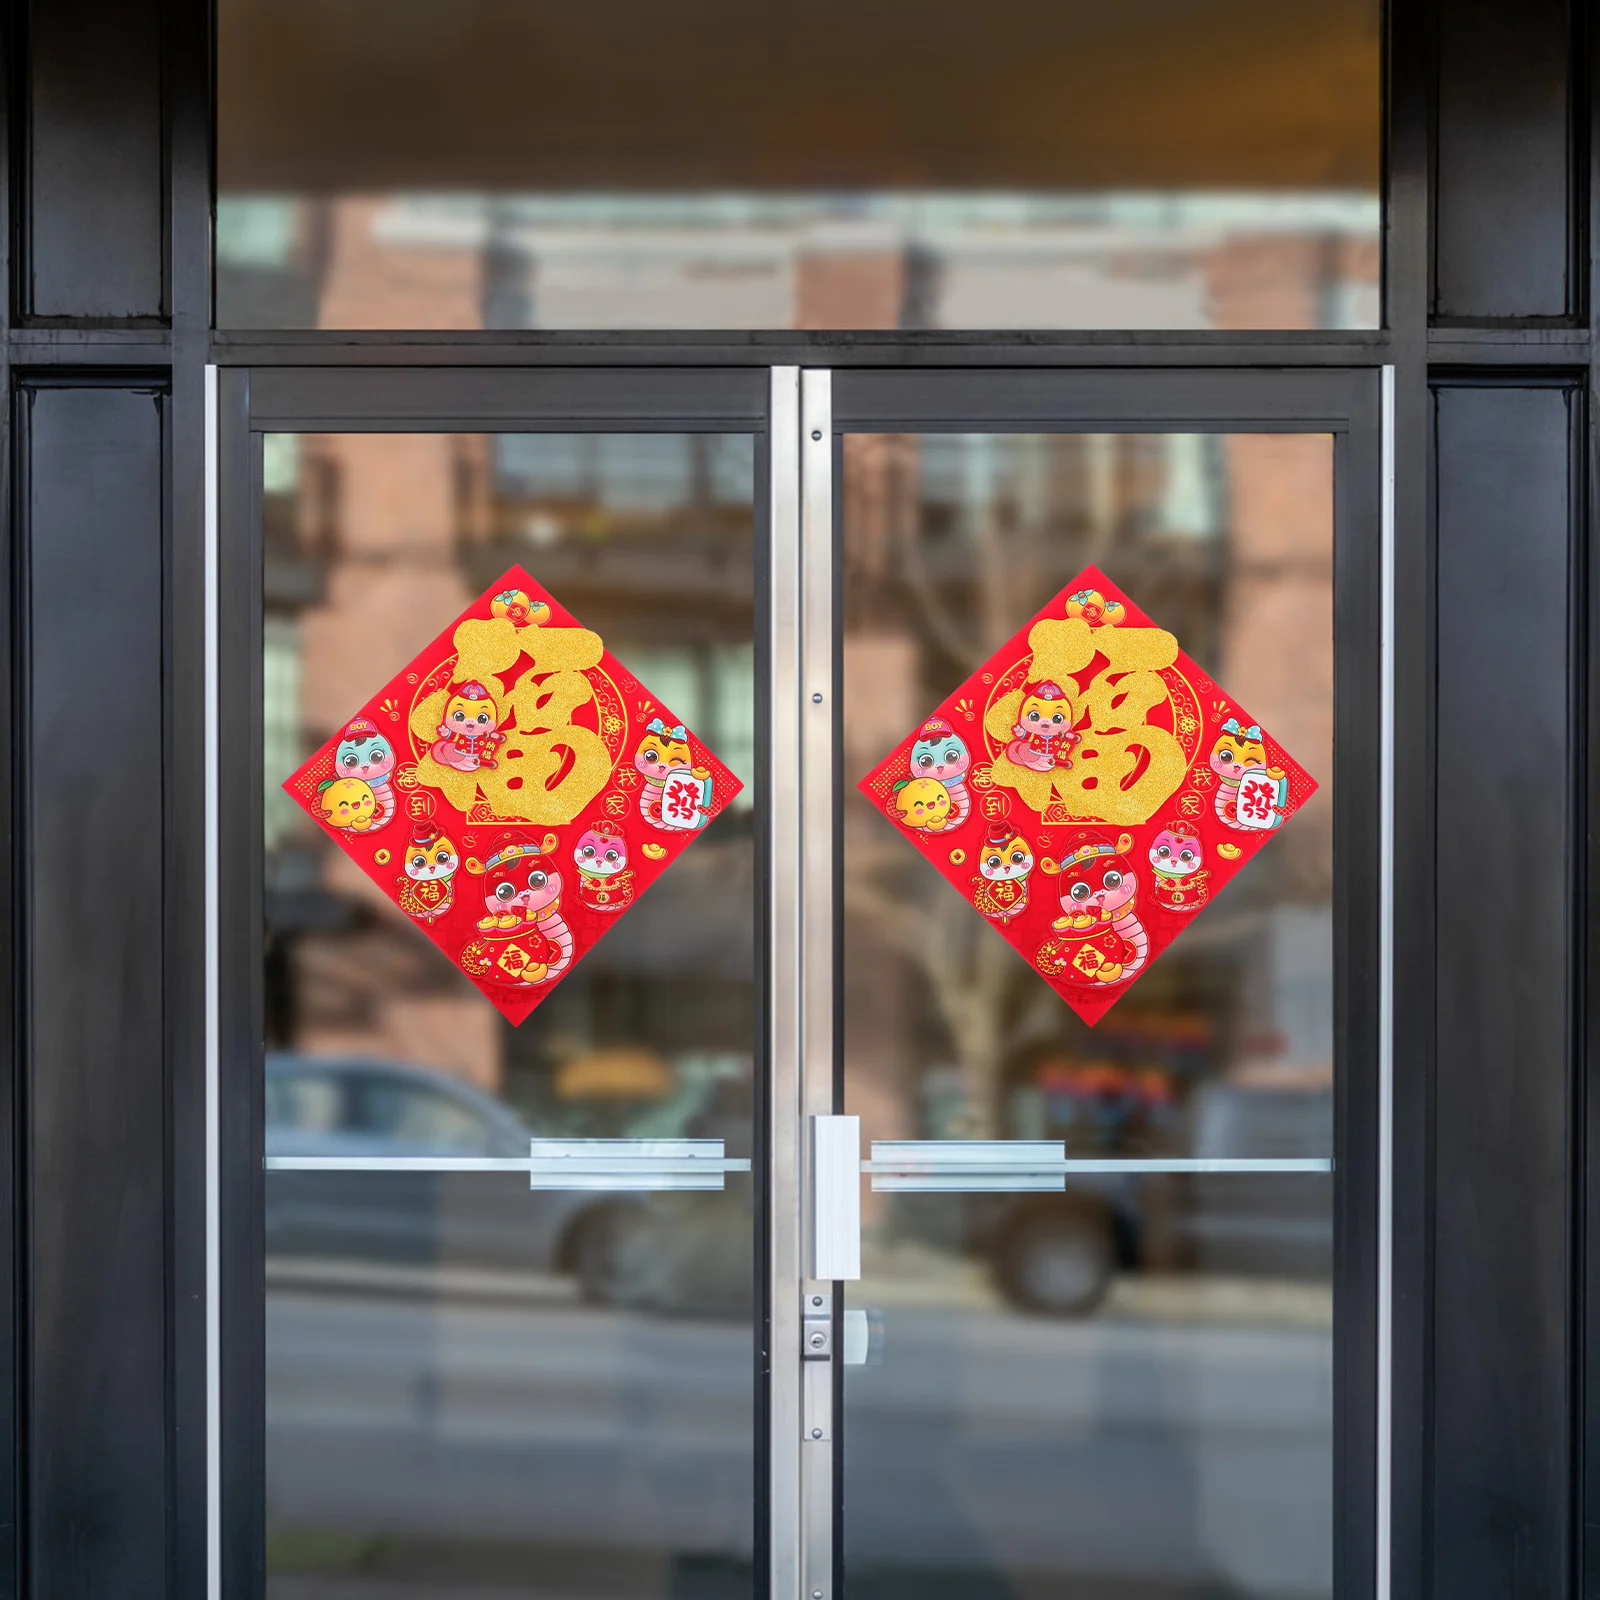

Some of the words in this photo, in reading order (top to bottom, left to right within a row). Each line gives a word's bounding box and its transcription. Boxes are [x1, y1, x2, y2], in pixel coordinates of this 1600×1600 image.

[350, 721, 368, 731] BOY
[925, 721, 943, 731] BOY
[420, 880, 440, 902] 福
[995, 880, 1015, 902] 福
[503, 949, 524, 971] 福
[1078, 949, 1099, 971] 福
